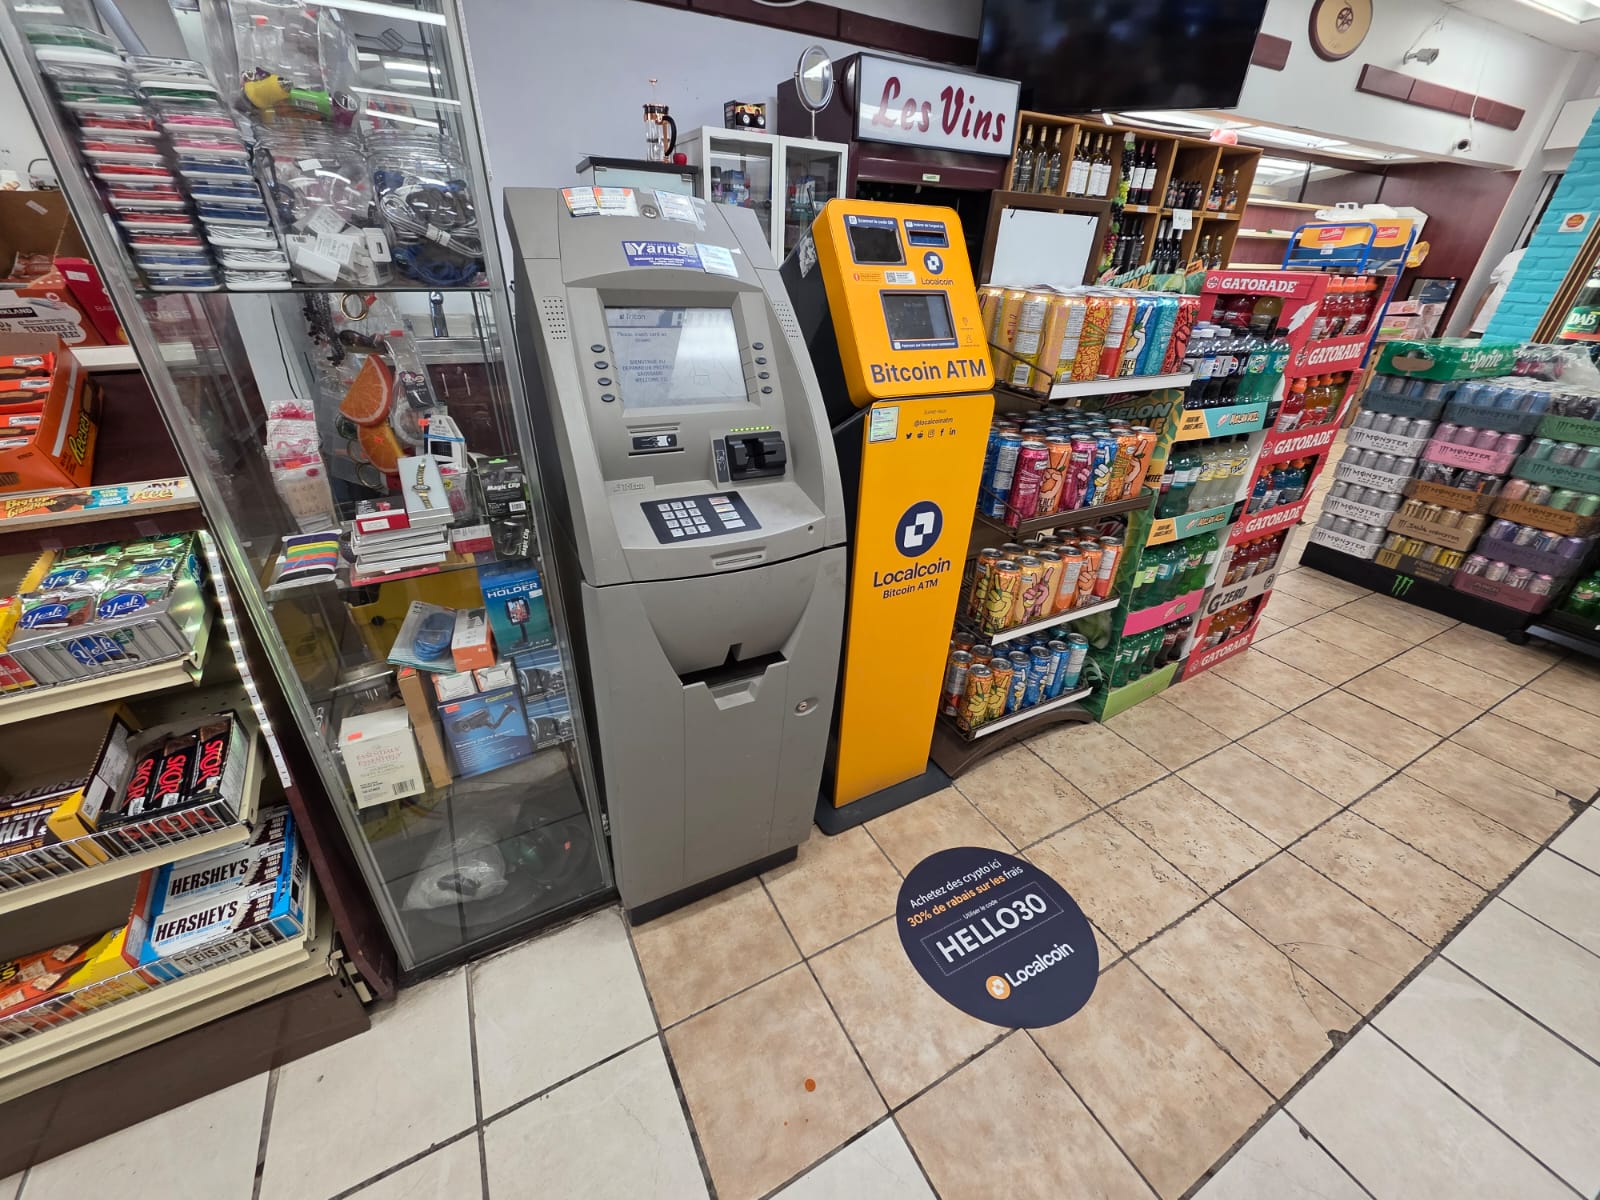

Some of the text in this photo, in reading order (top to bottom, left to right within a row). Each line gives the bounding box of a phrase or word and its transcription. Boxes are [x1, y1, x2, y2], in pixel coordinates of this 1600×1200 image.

[872, 76, 1006, 143] Les Vins
[631, 241, 687, 256] Yanus
[920, 277, 954, 287] Localcoin
[1221, 277, 1298, 293] GATORADE
[1570, 312, 1597, 326] DAB
[1307, 342, 1365, 365] GATORADE
[1470, 351, 1504, 372] Sprite
[870, 358, 987, 384] Bitcoin ATM
[1273, 430, 1335, 456] GATORADE
[1364, 433, 1409, 448] MONSTER
[1449, 447, 1491, 461] MONSTER
[487, 482, 521, 492] Magic Clip
[1352, 469, 1394, 485] MONSTER
[1245, 505, 1304, 533] GATORADE
[1340, 502, 1382, 518] MONSTER
[1327, 534, 1366, 551] MONSTER
[873, 557, 951, 588] Localcoin
[487, 582, 538, 599] HOLDER
[882, 578, 938, 599] Bitcoin ATM
[1207, 585, 1248, 615] G ZERO
[22, 608, 63, 626] York
[103, 595, 140, 617] York
[1200, 634, 1250, 666] GATORADE
[197, 740, 224, 784] SKOR
[123, 758, 155, 808] SKOR
[154, 754, 187, 800] SKOR
[170, 858, 250, 897] HERSHEY'S
[909, 858, 1002, 909] Achetez des crypto ici
[906, 864, 1024, 928] 30% de rabais sur les frais
[962, 906, 981, 919] Utiliser
[984, 898, 999, 909] code
[155, 900, 238, 943] HERSHEY'S
[935, 893, 1048, 963] HELLO30
[1004, 942, 1075, 988] Localcoin
